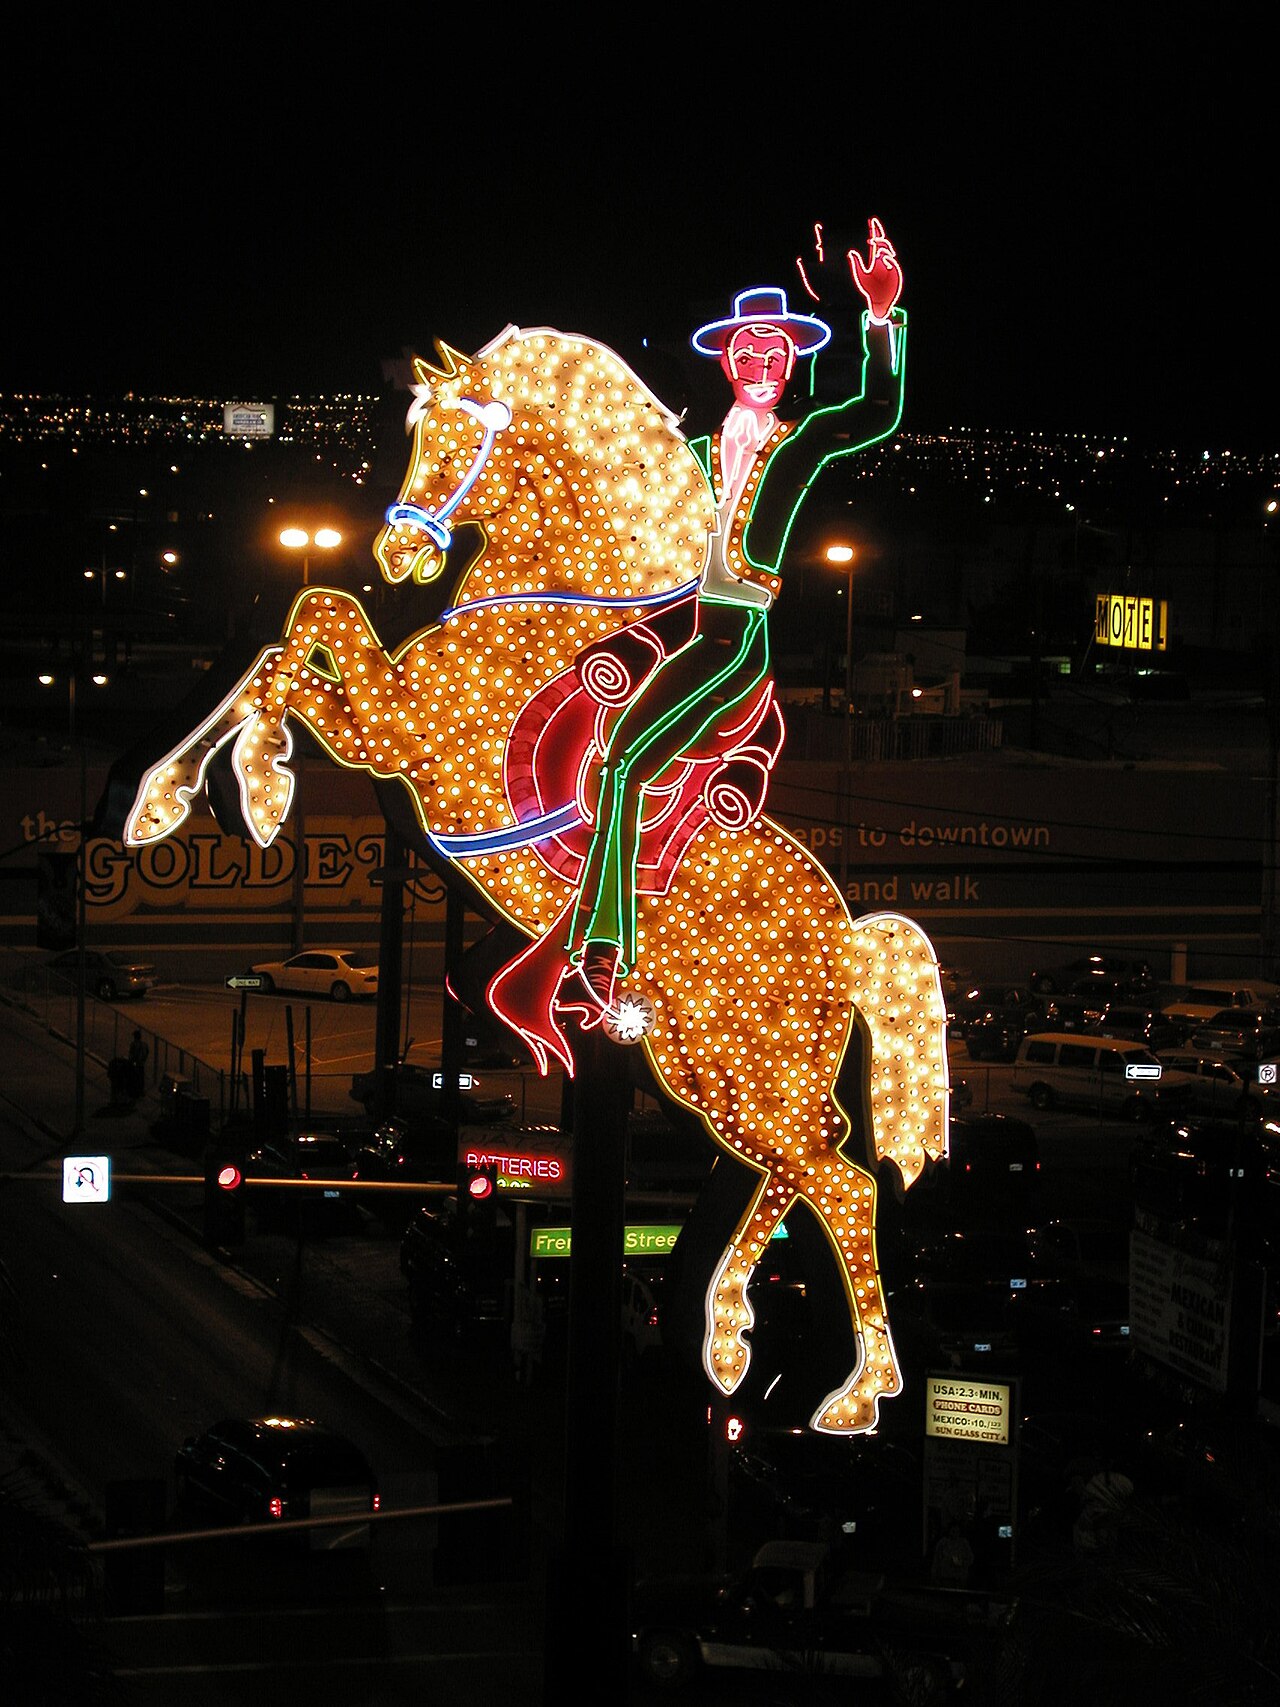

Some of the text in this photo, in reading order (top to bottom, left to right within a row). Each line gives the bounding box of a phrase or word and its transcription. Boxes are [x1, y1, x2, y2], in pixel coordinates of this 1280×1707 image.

[1097, 601, 1164, 644] MOTEL
[20, 810, 77, 842] the
[795, 821, 1051, 849] eps to downtown
[847, 876, 980, 901] and walk
[536, 1235, 571, 1250] Fre
[625, 1233, 677, 1248] Stree
[935, 1401, 1000, 1415] PHONE CARDS
[954, 1429, 979, 1438] GLASS
[982, 1432, 1000, 1440] CITY
